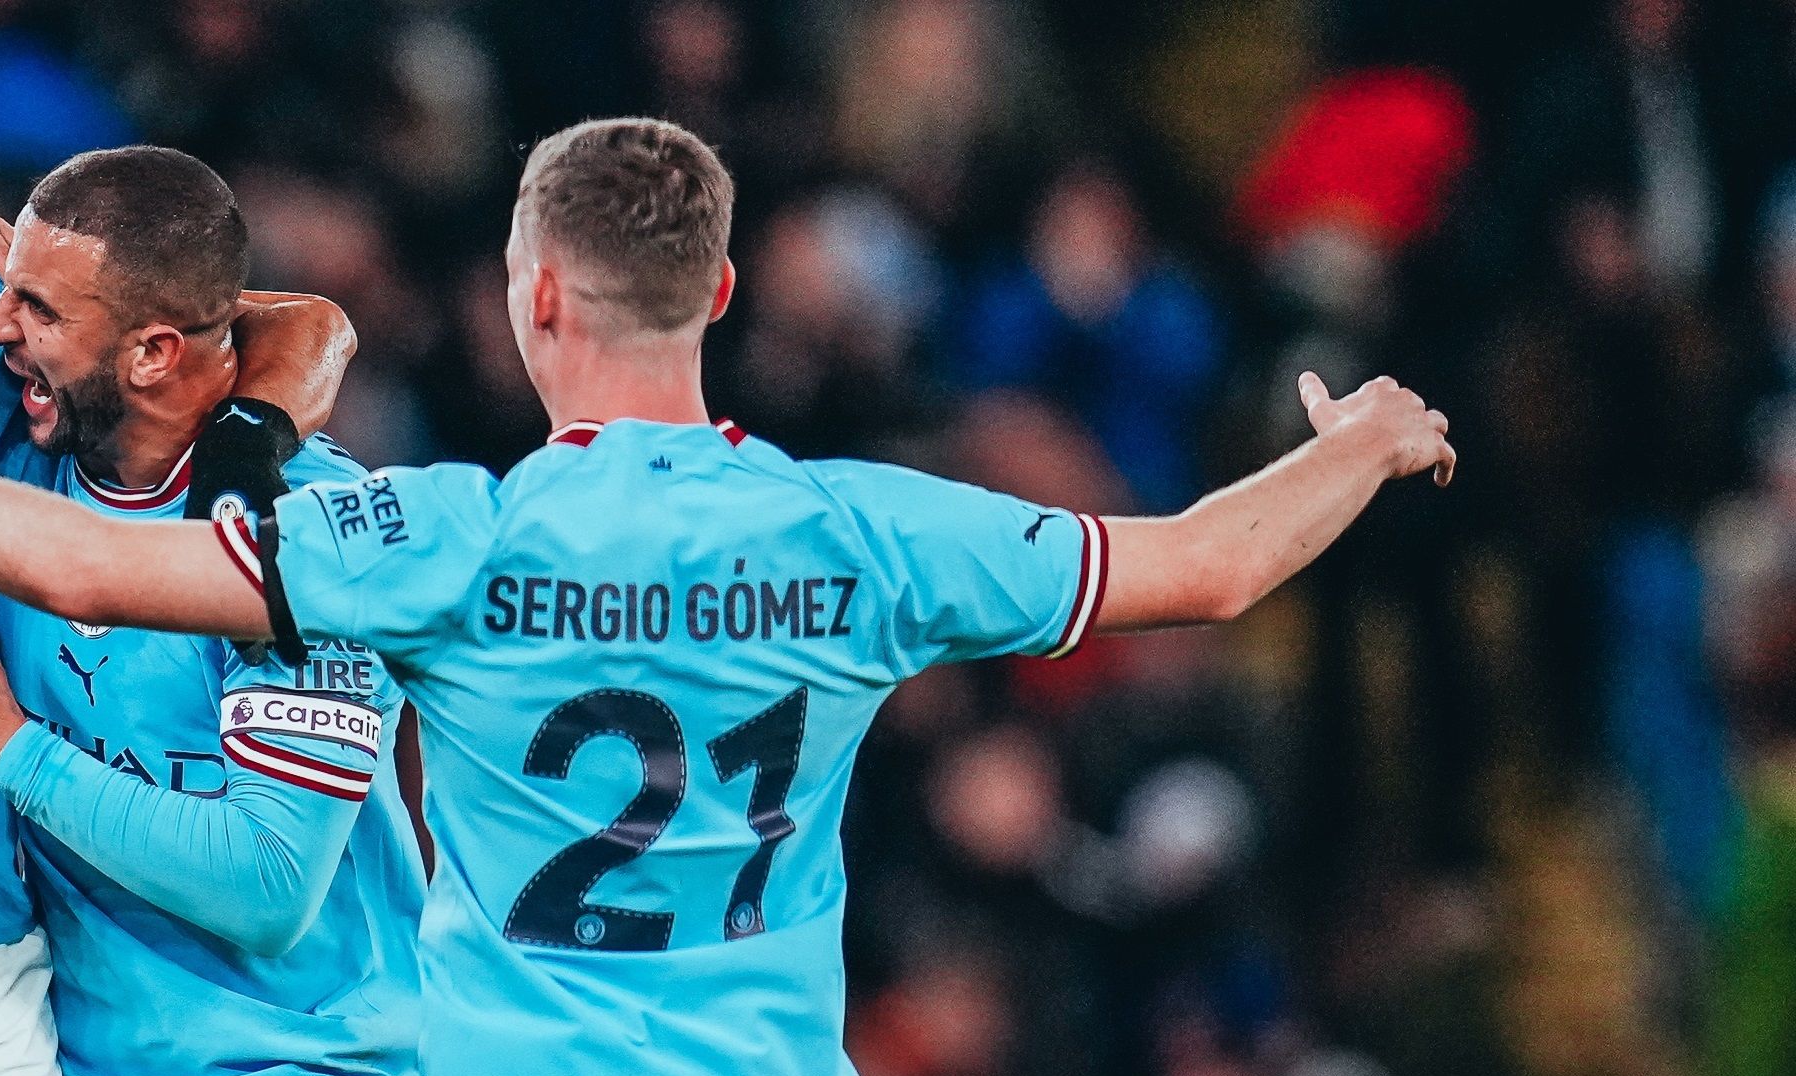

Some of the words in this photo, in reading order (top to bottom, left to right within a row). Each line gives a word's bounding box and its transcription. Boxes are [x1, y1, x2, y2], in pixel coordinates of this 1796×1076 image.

[484, 576, 671, 643] SERGIO
[686, 556, 857, 641] GÓMEZ
[294, 659, 374, 690] TIRE
[263, 699, 381, 744] Captain
[504, 686, 808, 952] 21
